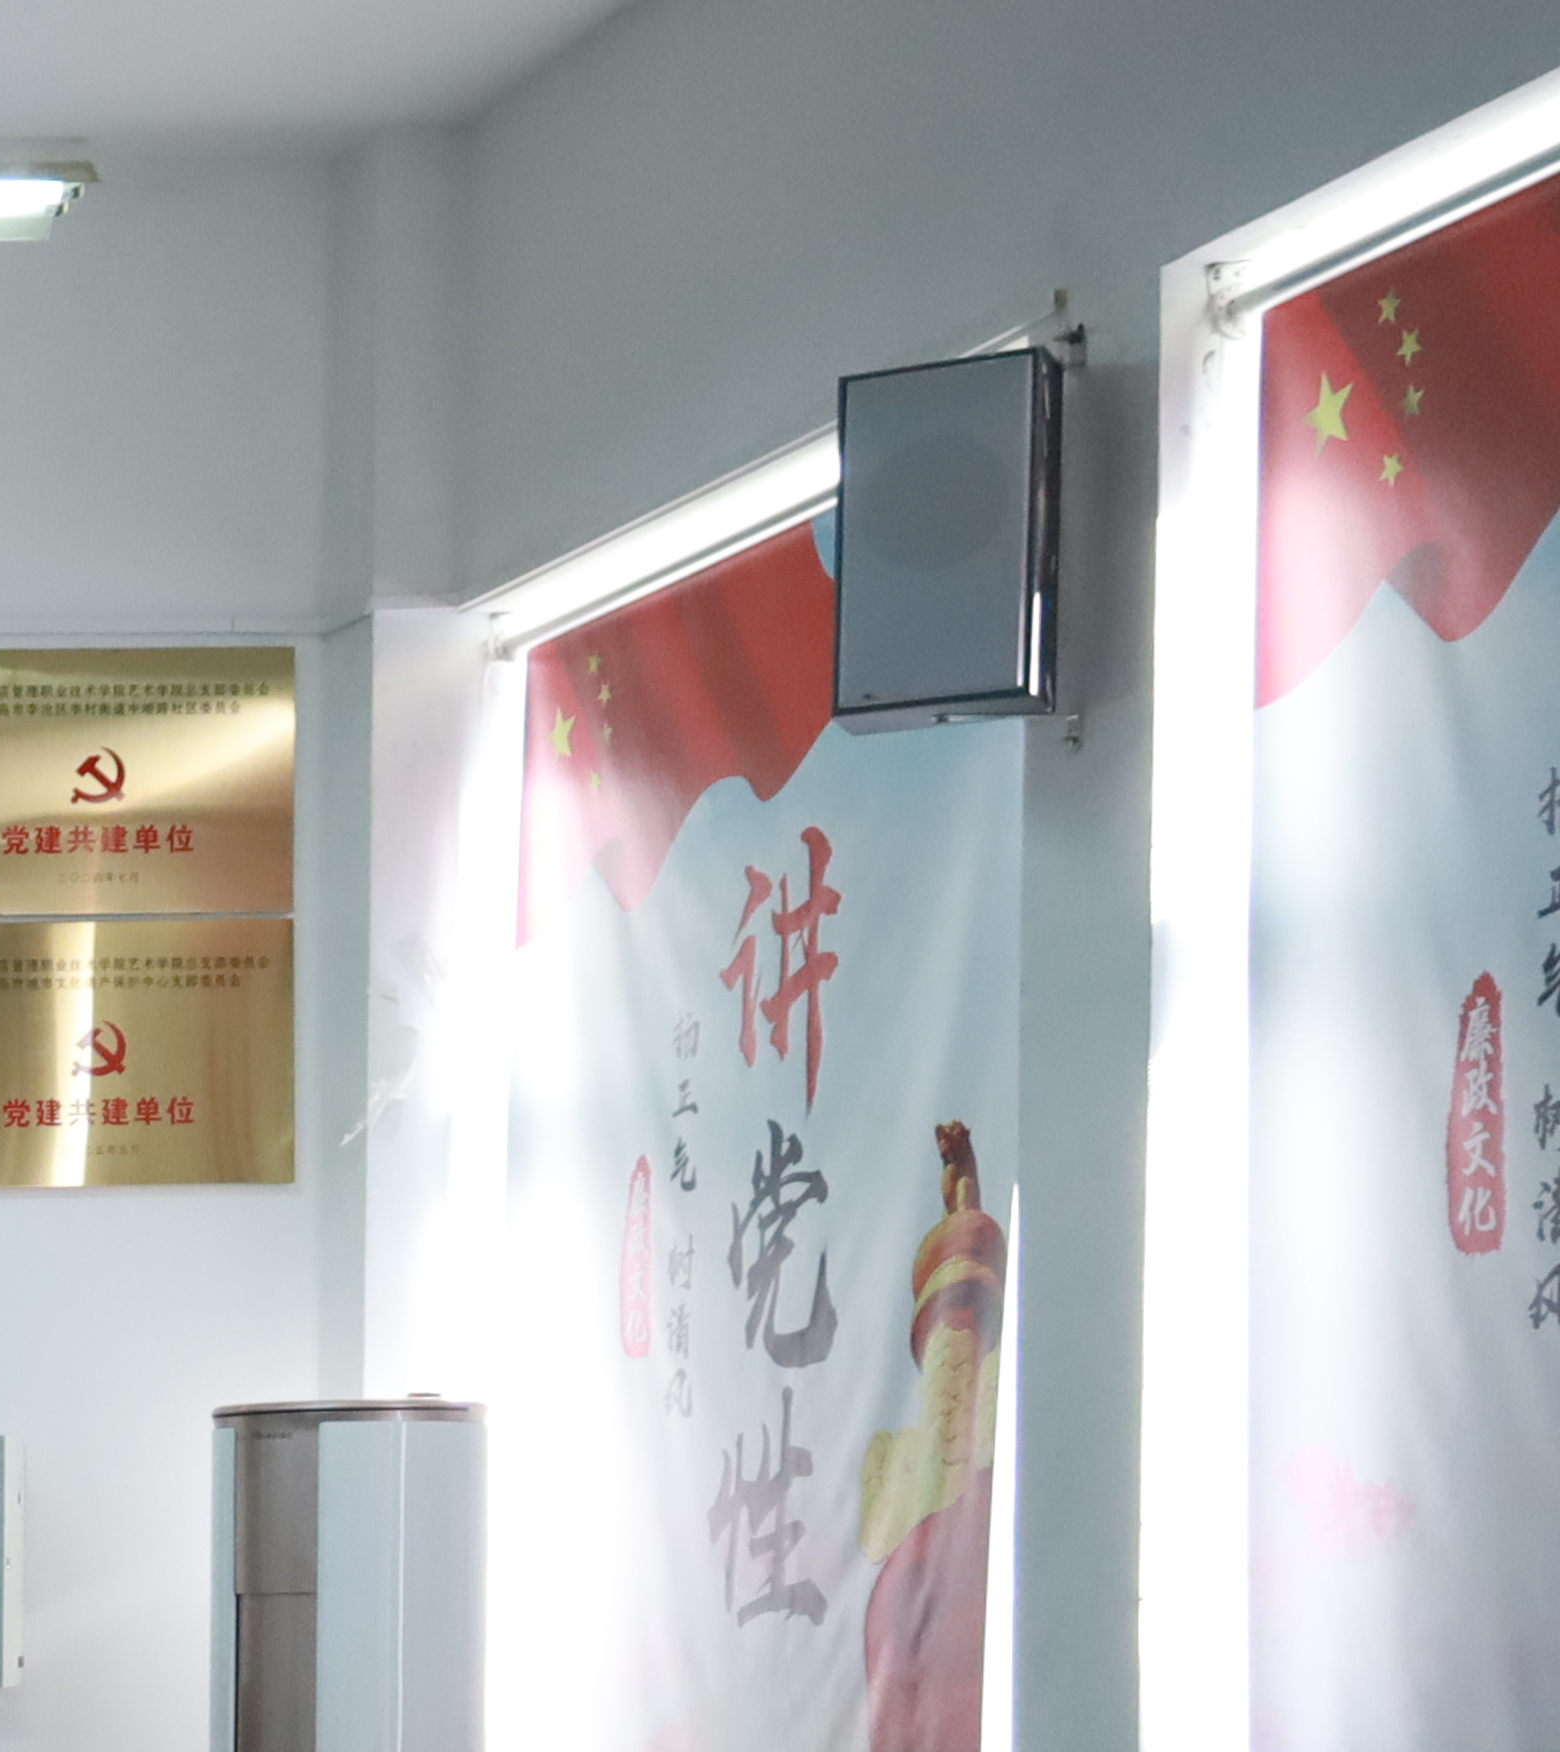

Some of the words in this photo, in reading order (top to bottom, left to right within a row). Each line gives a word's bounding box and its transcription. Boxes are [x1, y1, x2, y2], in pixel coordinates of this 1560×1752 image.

[1, 823, 195, 855] 党建共建单位
[2, 1096, 195, 1128] 党建共建单位
[1458, 996, 1500, 1237] 廉政文化
[707, 826, 842, 1628] 讲党性
